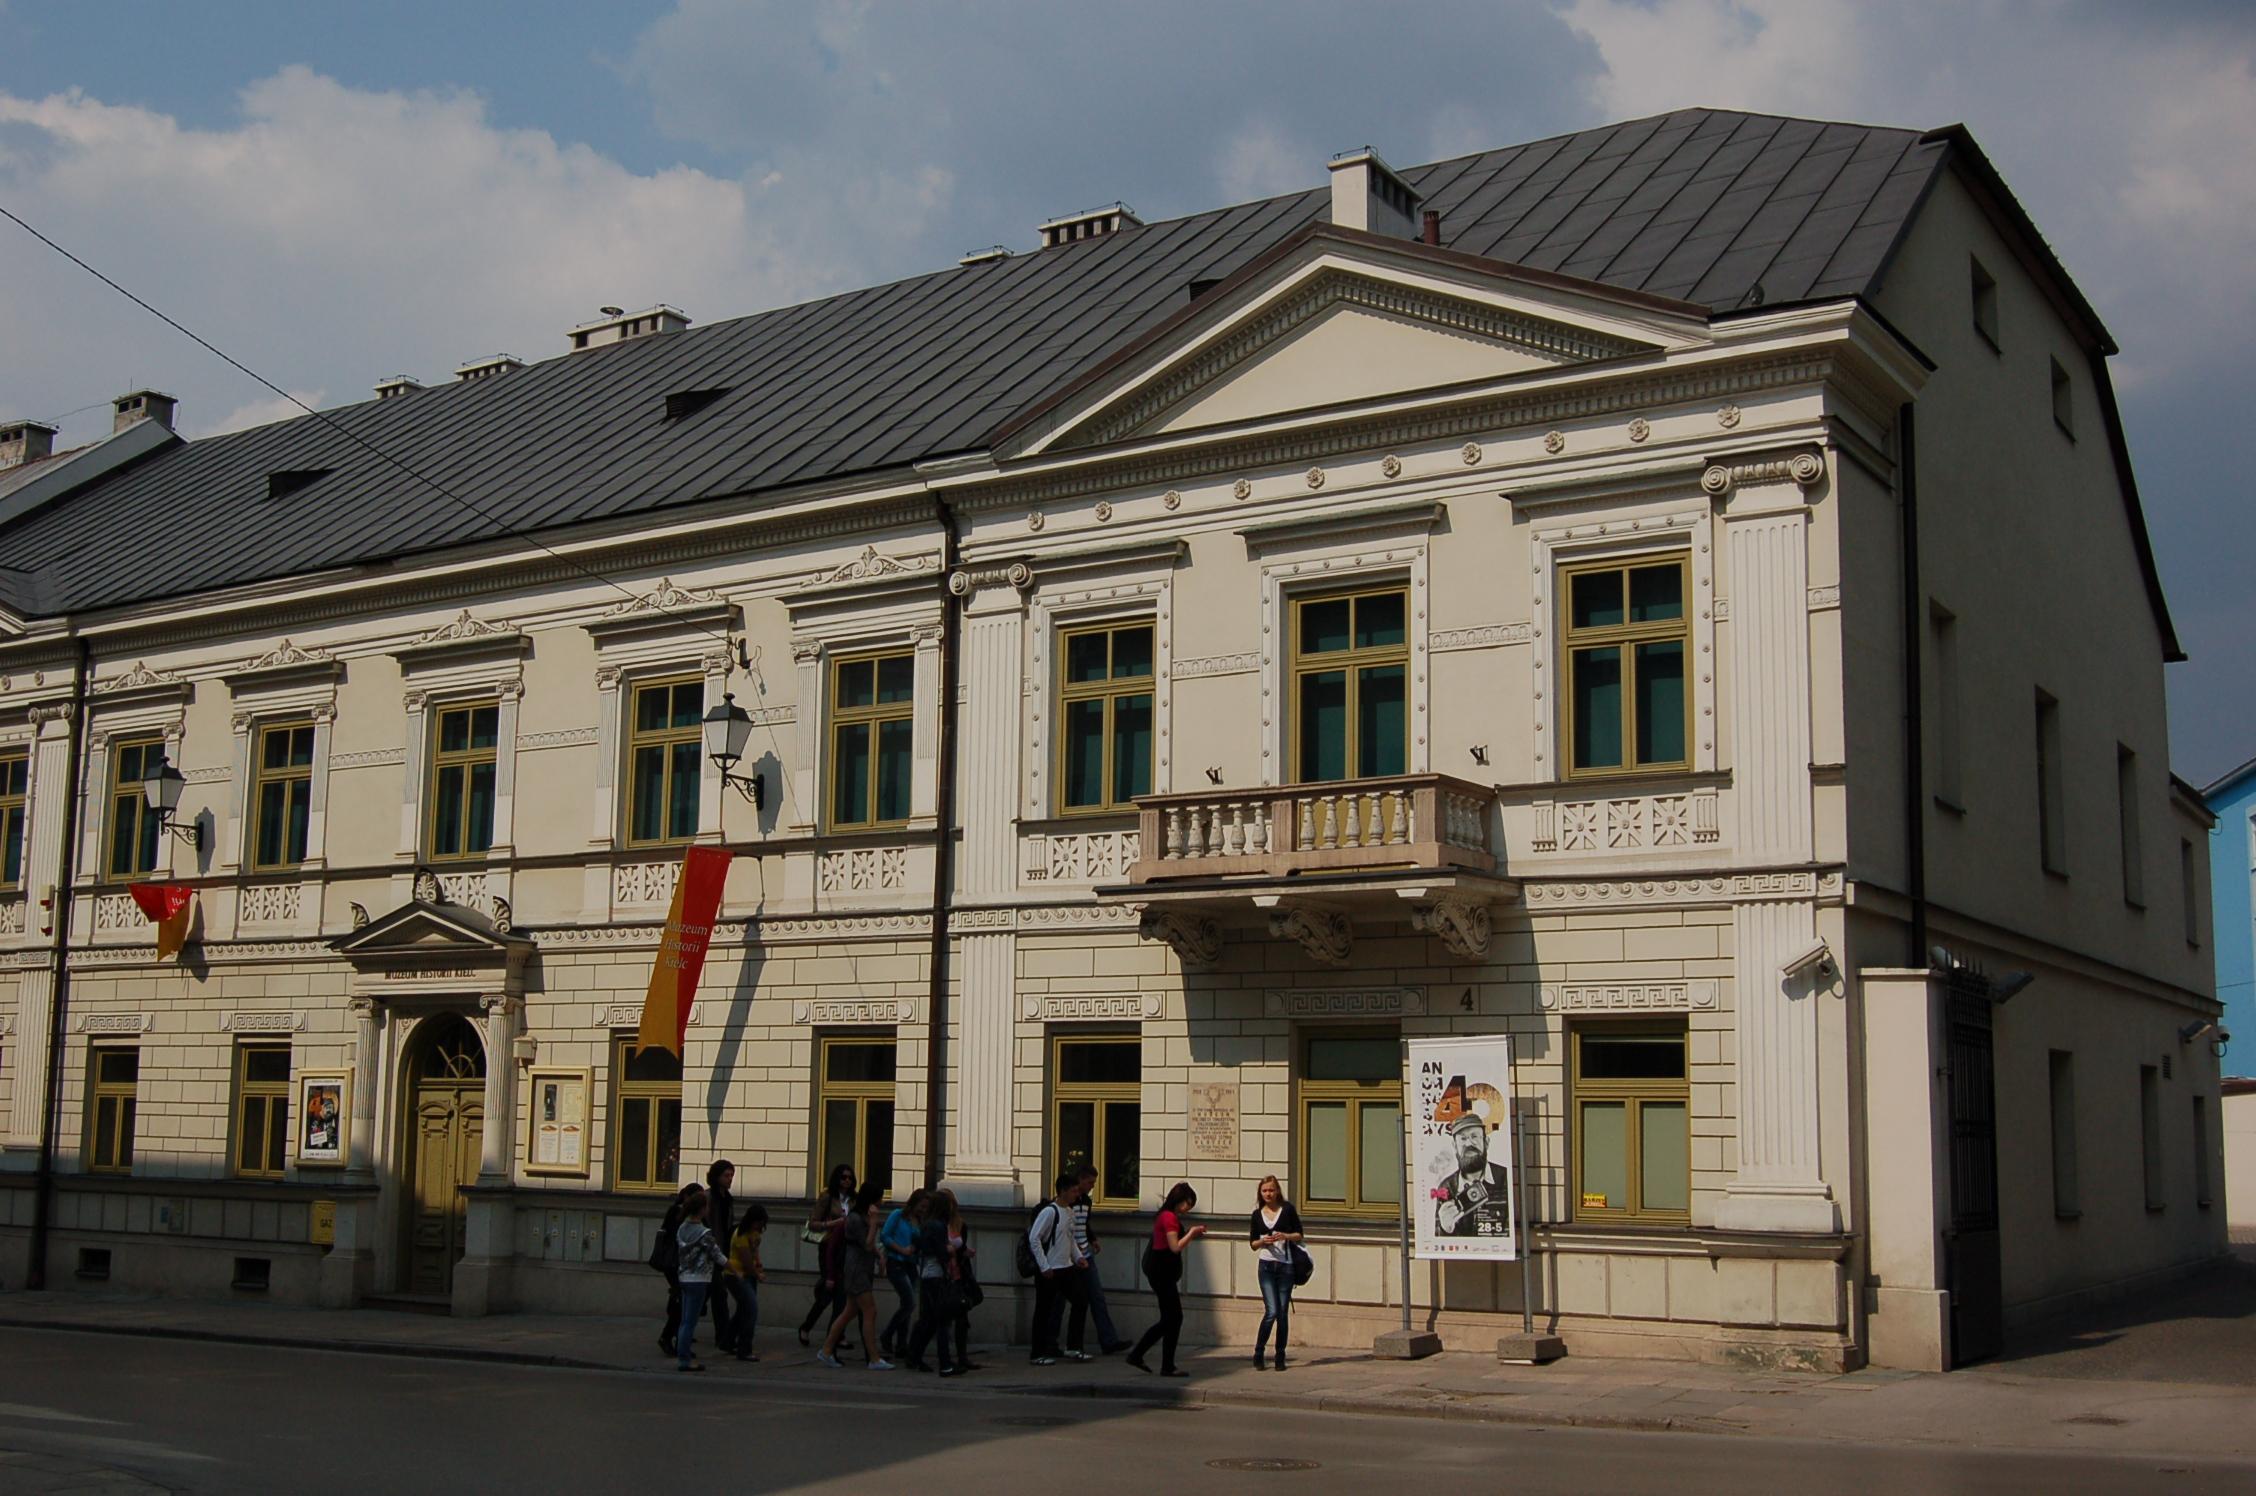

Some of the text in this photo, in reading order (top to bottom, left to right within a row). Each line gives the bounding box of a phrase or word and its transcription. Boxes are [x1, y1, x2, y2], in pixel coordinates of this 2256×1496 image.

[666, 920, 708, 936] Muzeum
[664, 938, 701, 953] Historii
[664, 956, 689, 969] Kielc
[384, 966, 477, 980] MUZEUM HISTORII KIELC
[1460, 987, 1474, 1011] 4
[1421, 1062, 1442, 1074] AN
